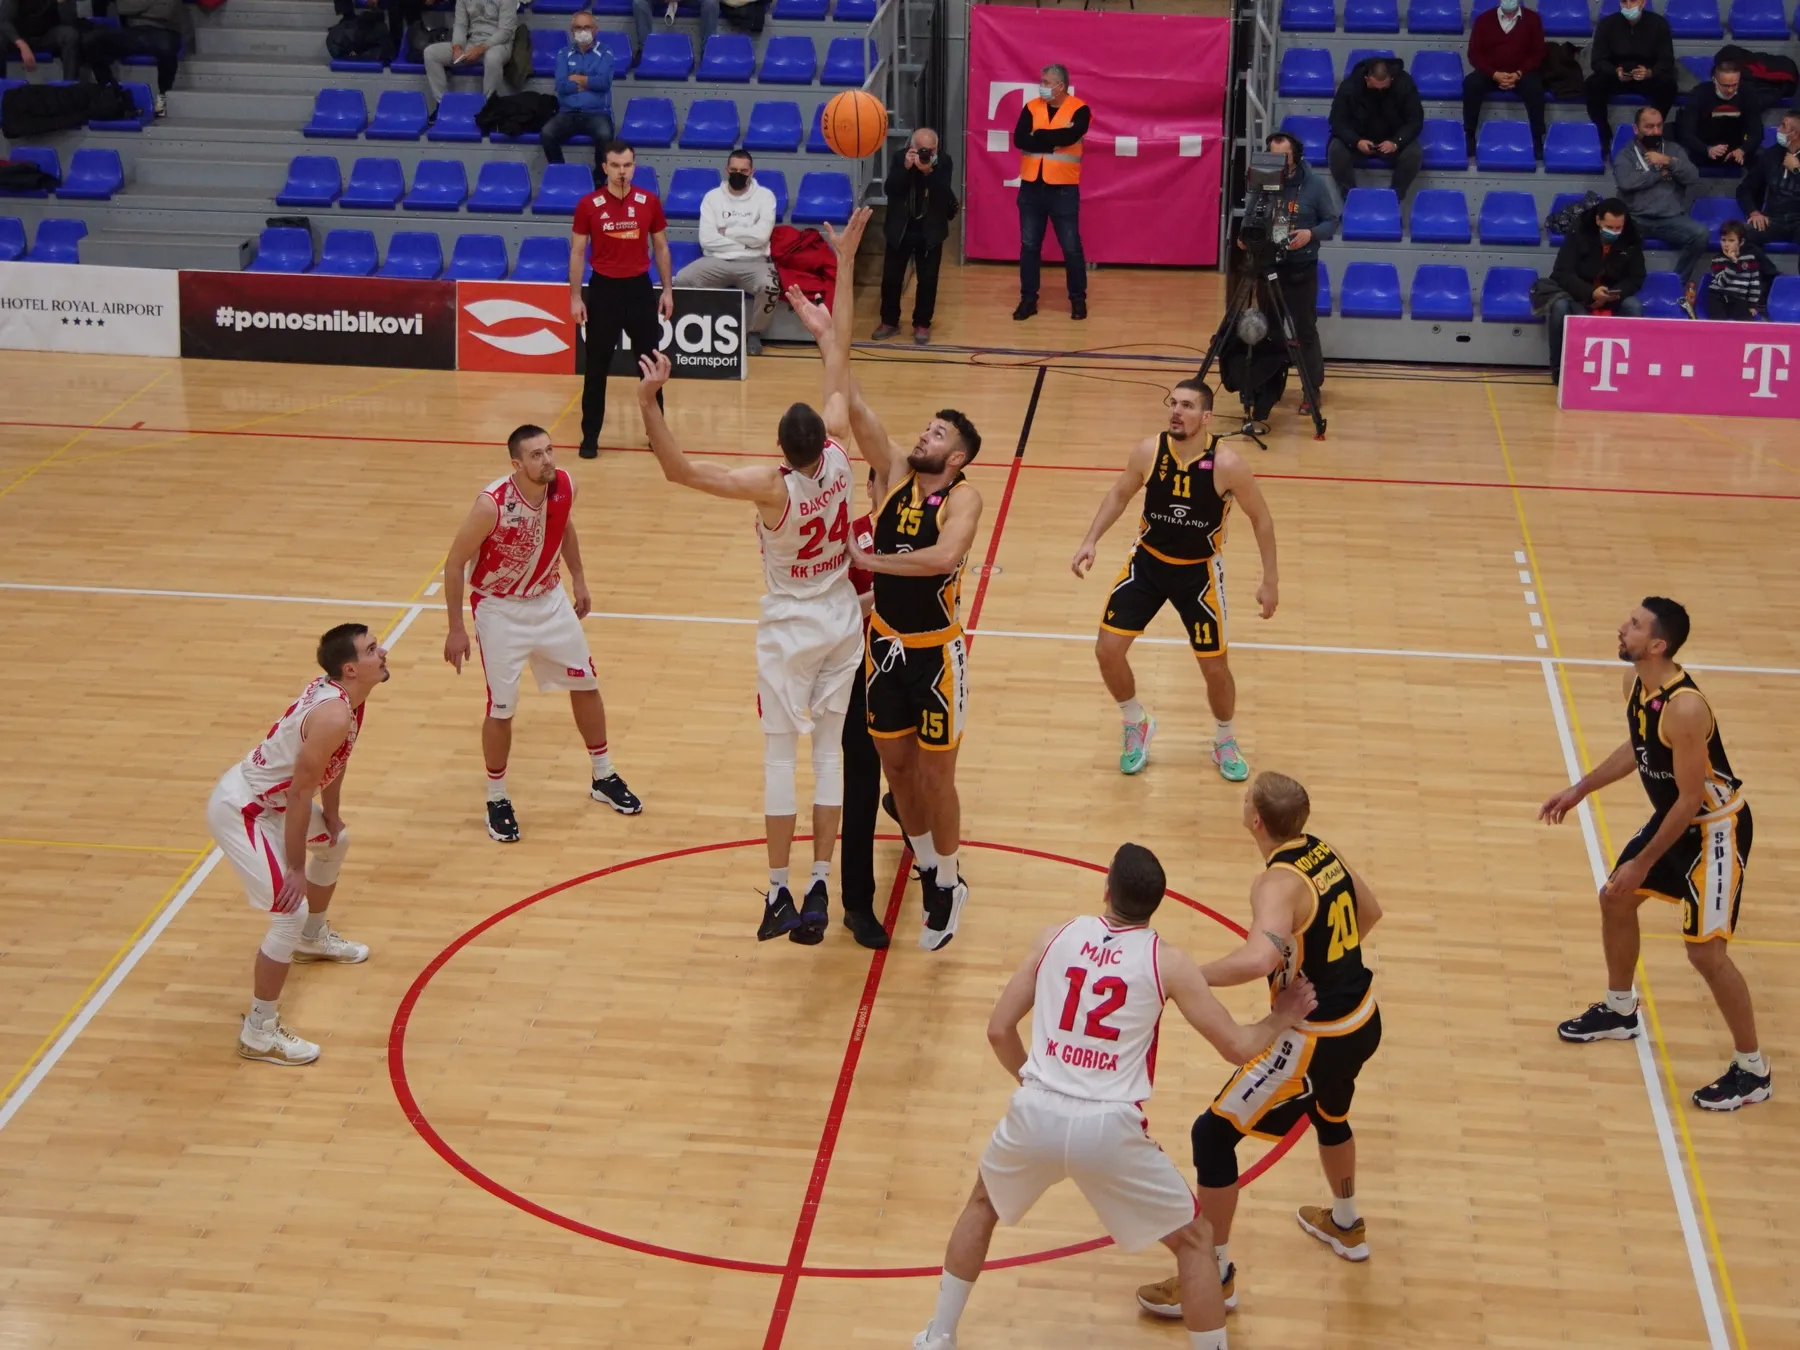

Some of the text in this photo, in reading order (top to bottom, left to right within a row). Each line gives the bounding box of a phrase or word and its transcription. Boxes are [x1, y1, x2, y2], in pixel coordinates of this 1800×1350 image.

[1, 297, 164, 317] HOTEL ROYAL AIRPORT
[216, 306, 423, 335] #ponosnibikovi
[676, 353, 738, 368] Teamsport
[800, 472, 848, 517] BAKOVIĆ
[1172, 473, 1191, 498] 11
[797, 498, 851, 560] 24
[897, 506, 924, 537] 15
[1150, 512, 1183, 526] OPTIKA
[790, 564, 808, 578] KK
[1194, 621, 1213, 645] 11
[921, 709, 944, 739] 15
[1327, 890, 1359, 963] 20
[1058, 966, 1128, 1042] 12
[1061, 1044, 1120, 1072] GORICA
